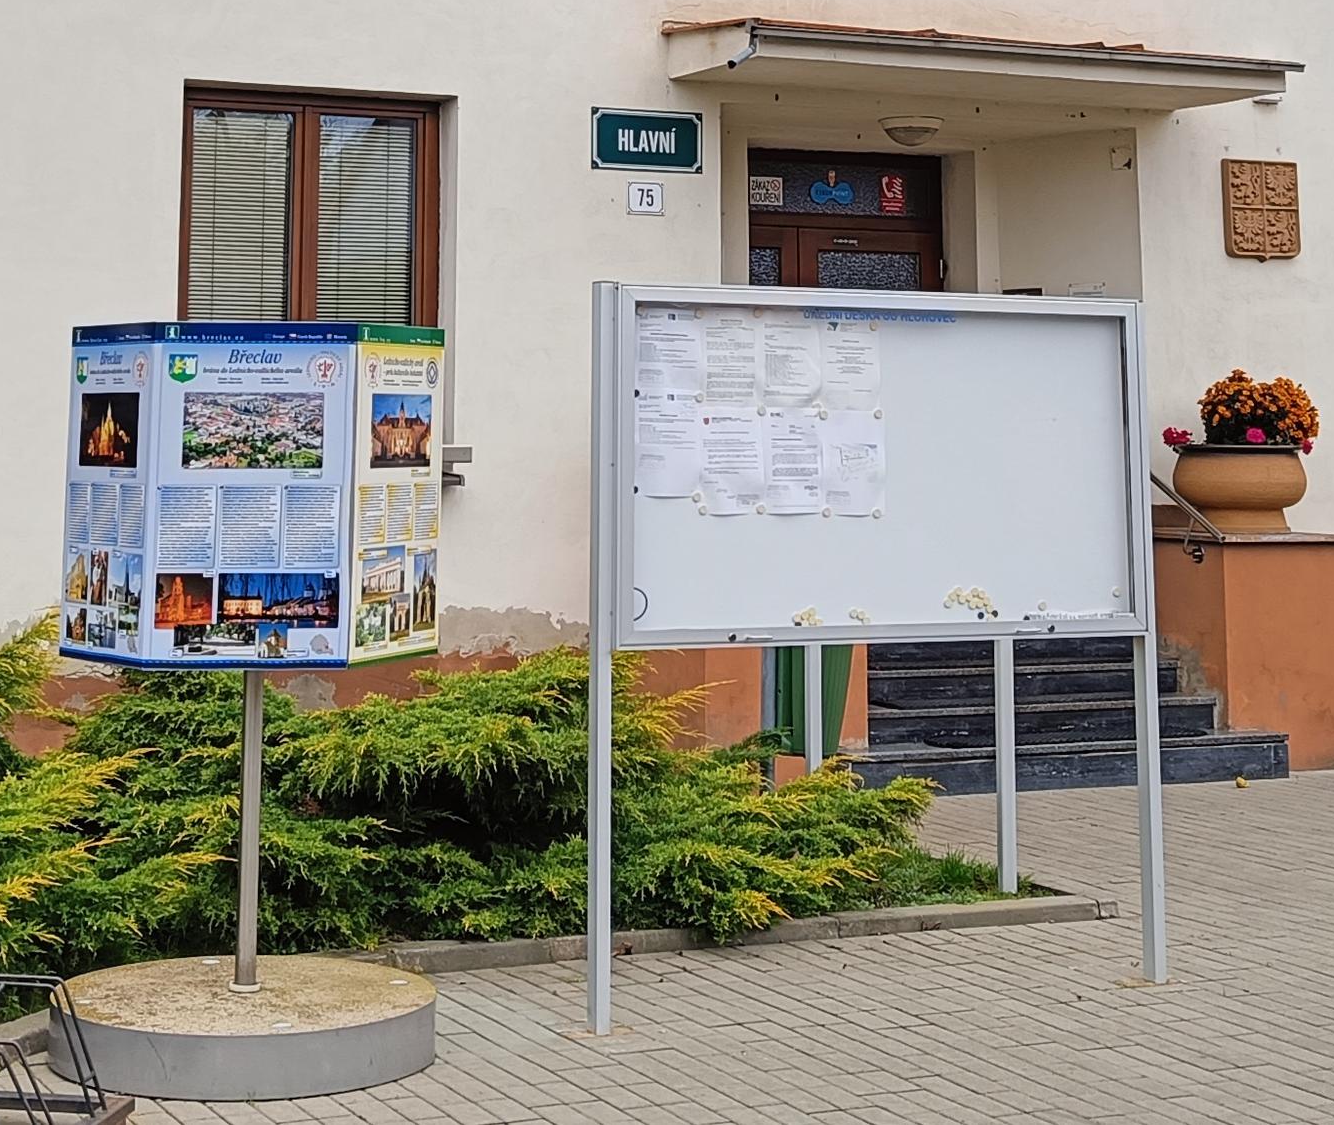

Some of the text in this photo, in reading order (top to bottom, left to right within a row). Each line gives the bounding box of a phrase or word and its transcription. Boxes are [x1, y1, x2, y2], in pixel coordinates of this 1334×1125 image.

[618, 127, 677, 154] HLAVNÍ
[637, 188, 654, 207] 75
[228, 348, 283, 364] Břeclav
